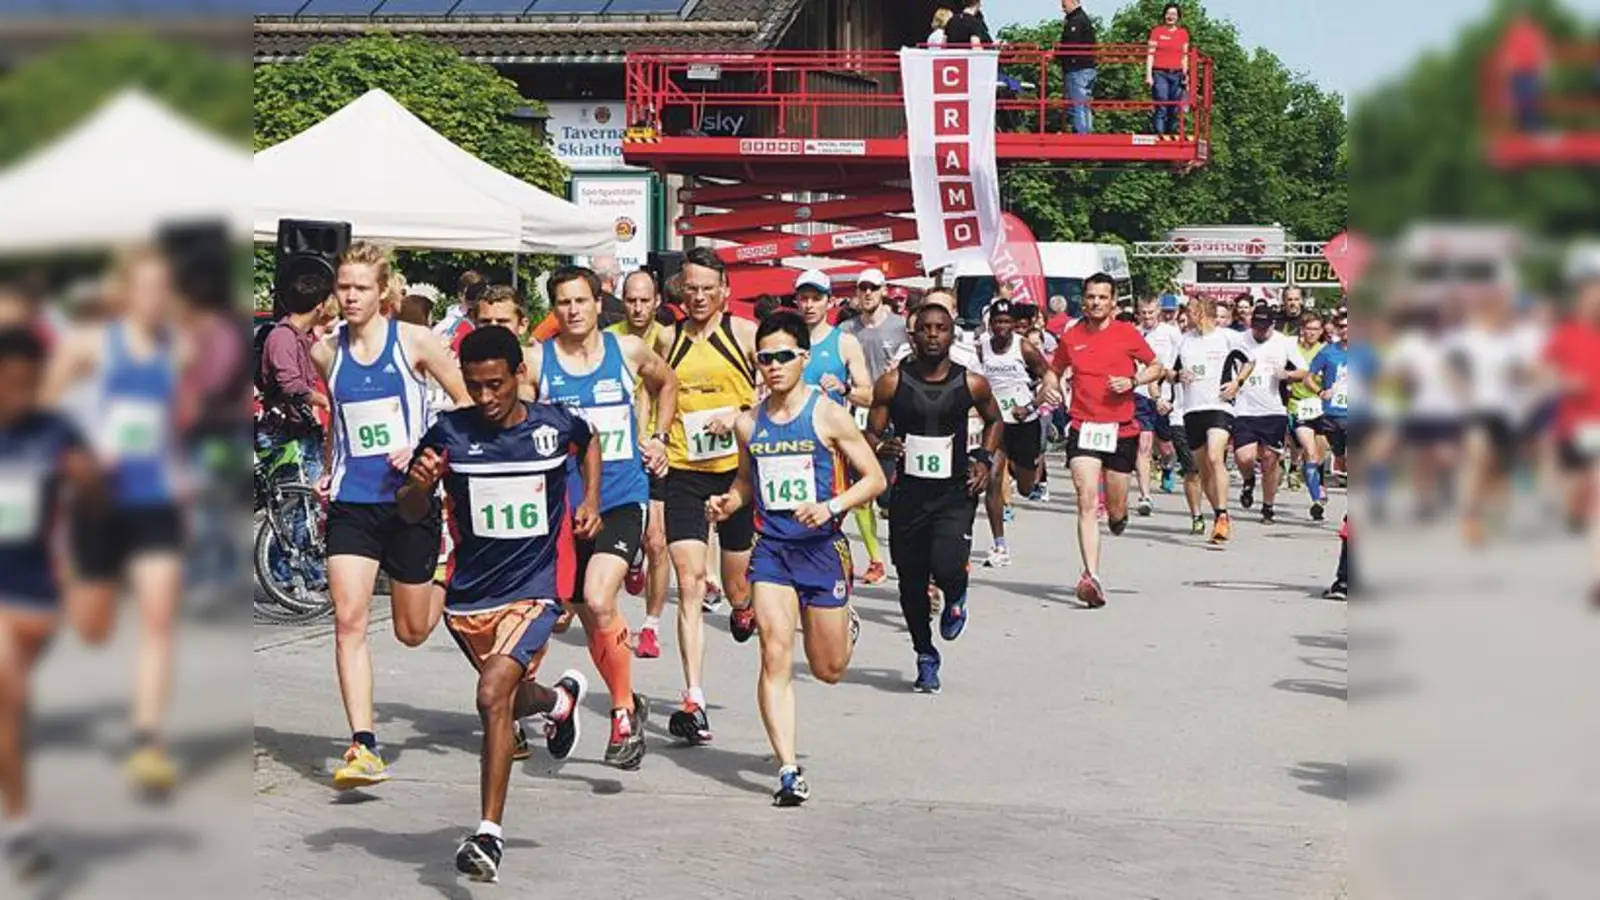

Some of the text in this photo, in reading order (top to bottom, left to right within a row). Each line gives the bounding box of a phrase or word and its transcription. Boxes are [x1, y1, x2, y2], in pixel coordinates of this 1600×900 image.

[560, 126, 627, 139] Taverna
[704, 110, 743, 135] sky
[940, 65, 973, 242] CRAMO
[358, 424, 390, 449] 95
[692, 430, 733, 453] 179
[750, 440, 815, 454] RUNS
[1085, 431, 1111, 448] 101
[915, 454, 940, 473] 18
[766, 479, 808, 502] 143
[481, 503, 539, 529] 116
